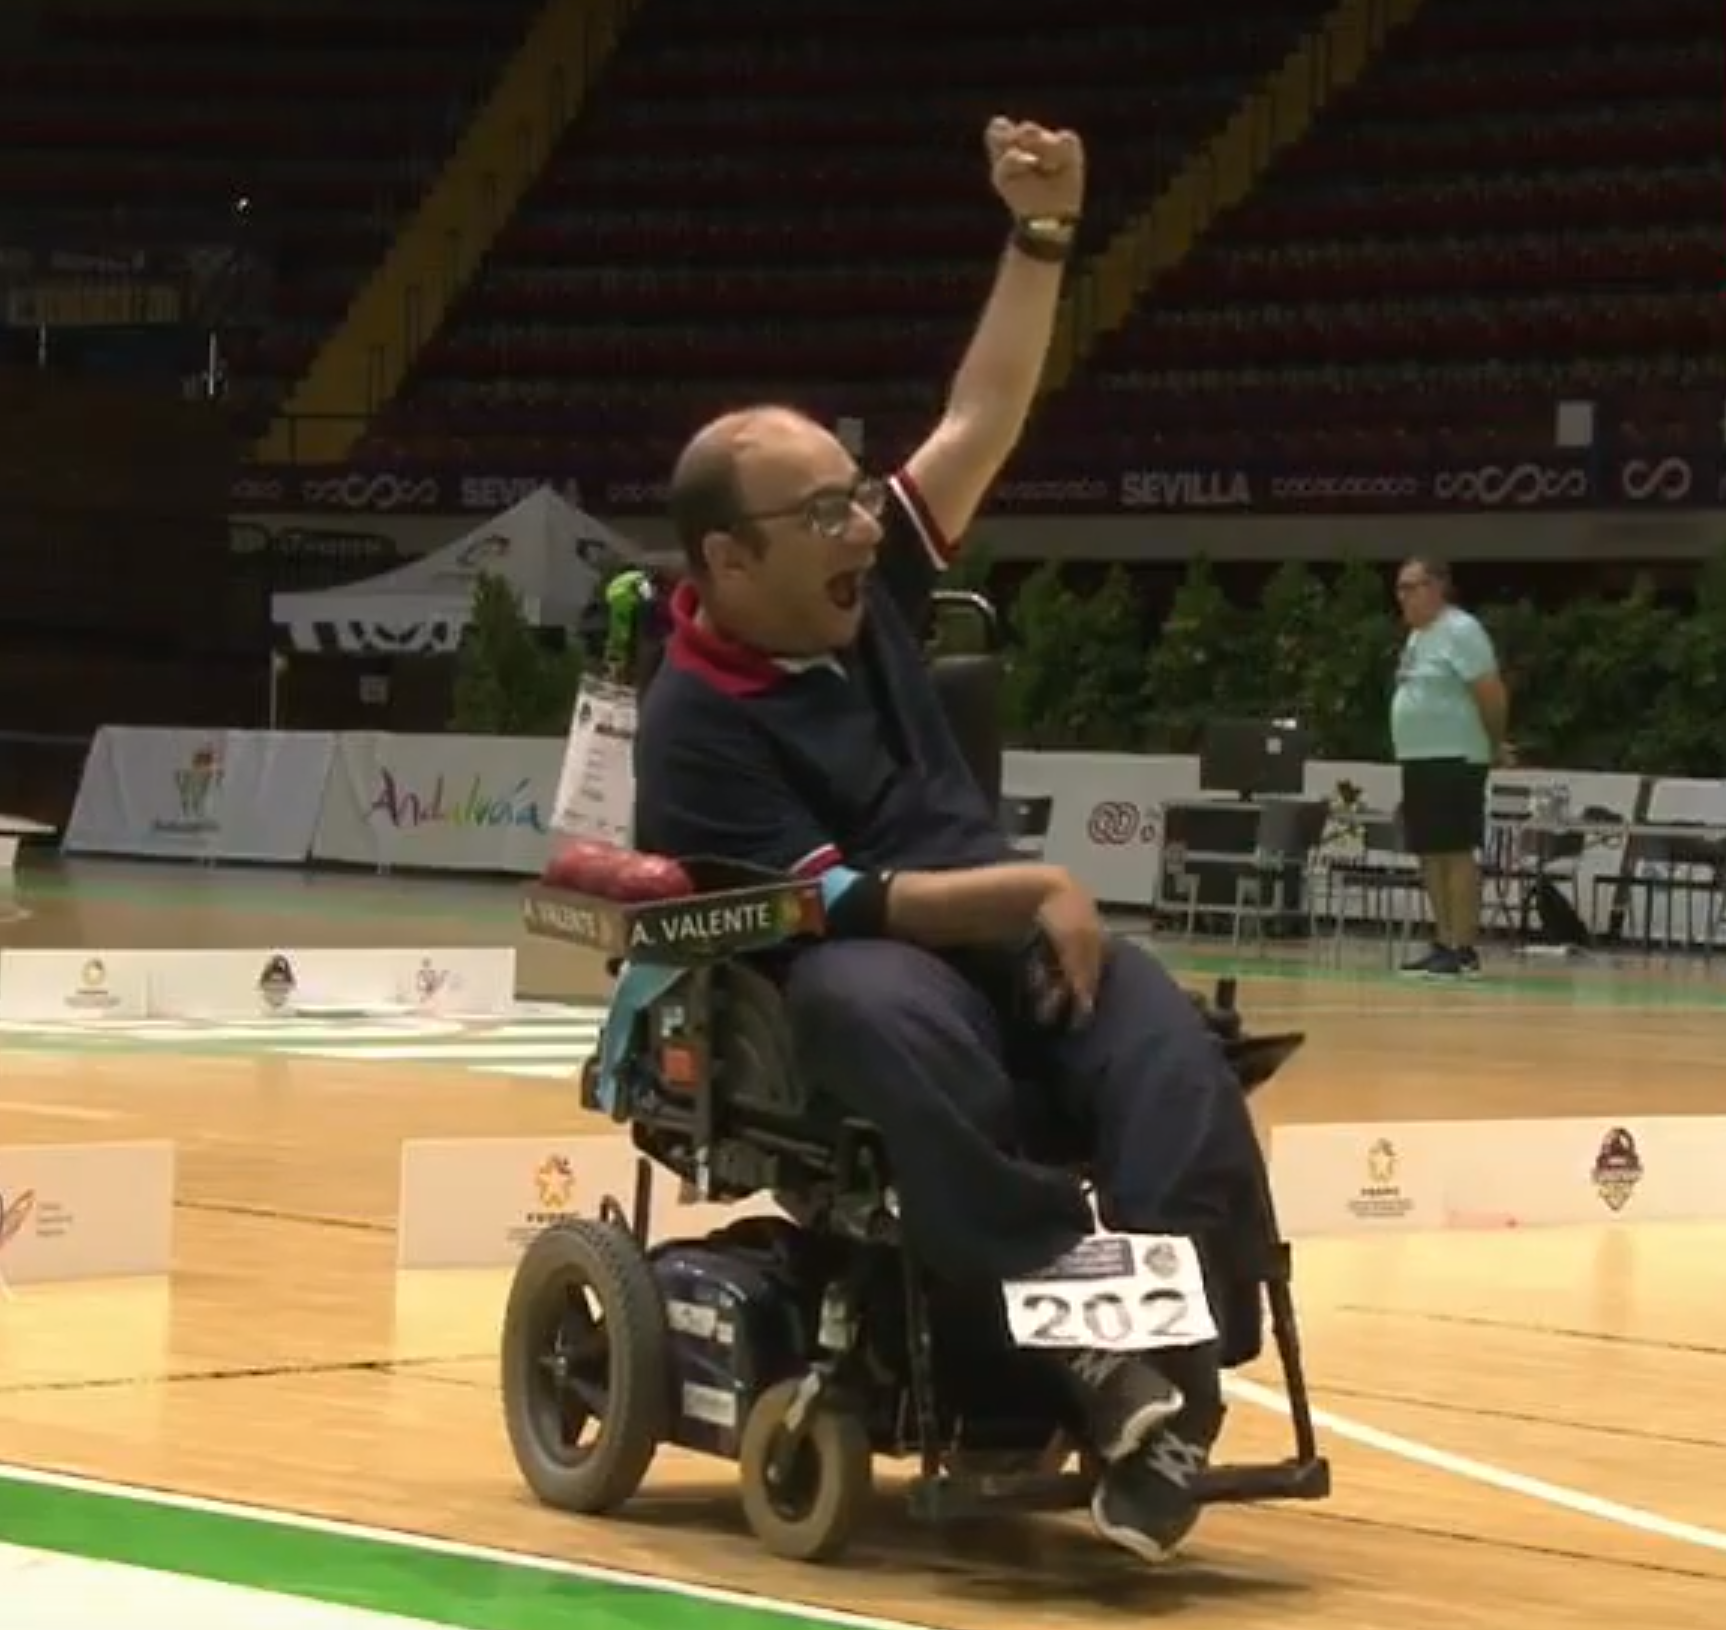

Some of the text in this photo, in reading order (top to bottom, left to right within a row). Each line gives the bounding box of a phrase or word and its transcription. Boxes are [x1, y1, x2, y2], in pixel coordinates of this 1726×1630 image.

[1121, 471, 1249, 506] SEVILLA
[630, 901, 771, 946] A. VALENTE
[1021, 1287, 1199, 1342] 202
